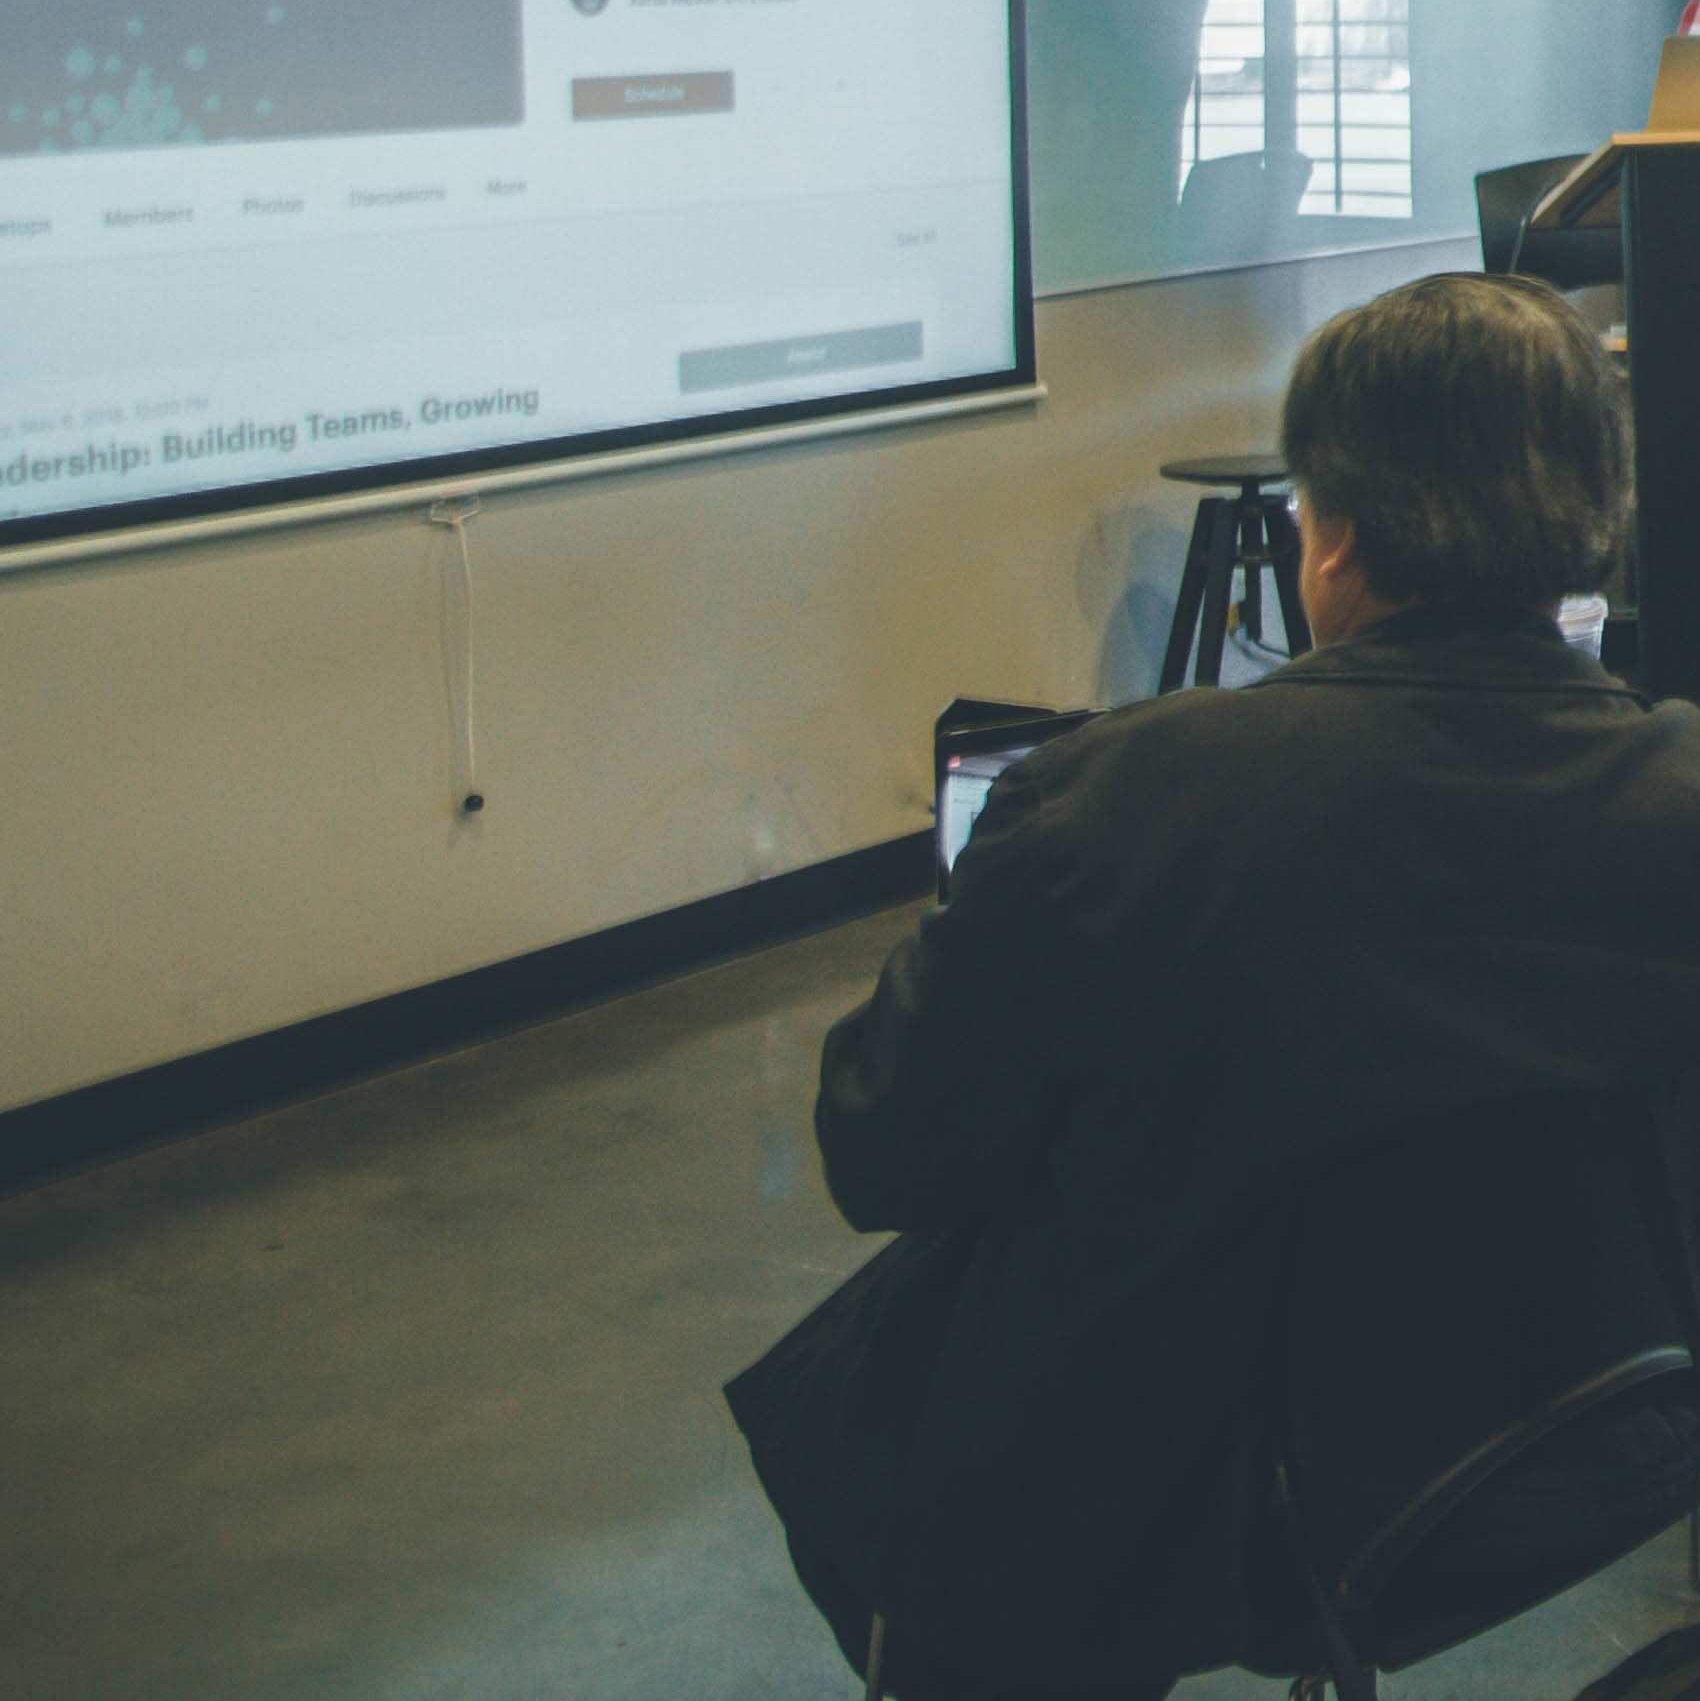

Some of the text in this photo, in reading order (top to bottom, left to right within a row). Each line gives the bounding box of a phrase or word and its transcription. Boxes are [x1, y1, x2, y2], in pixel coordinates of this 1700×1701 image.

[103, 205, 194, 229] Members
[242, 196, 304, 216] Photos
[349, 184, 446, 209] Discussions
[486, 178, 527, 196] More
[163, 417, 297, 463] Building
[306, 404, 412, 442] Teams,
[421, 387, 540, 426] Growing
